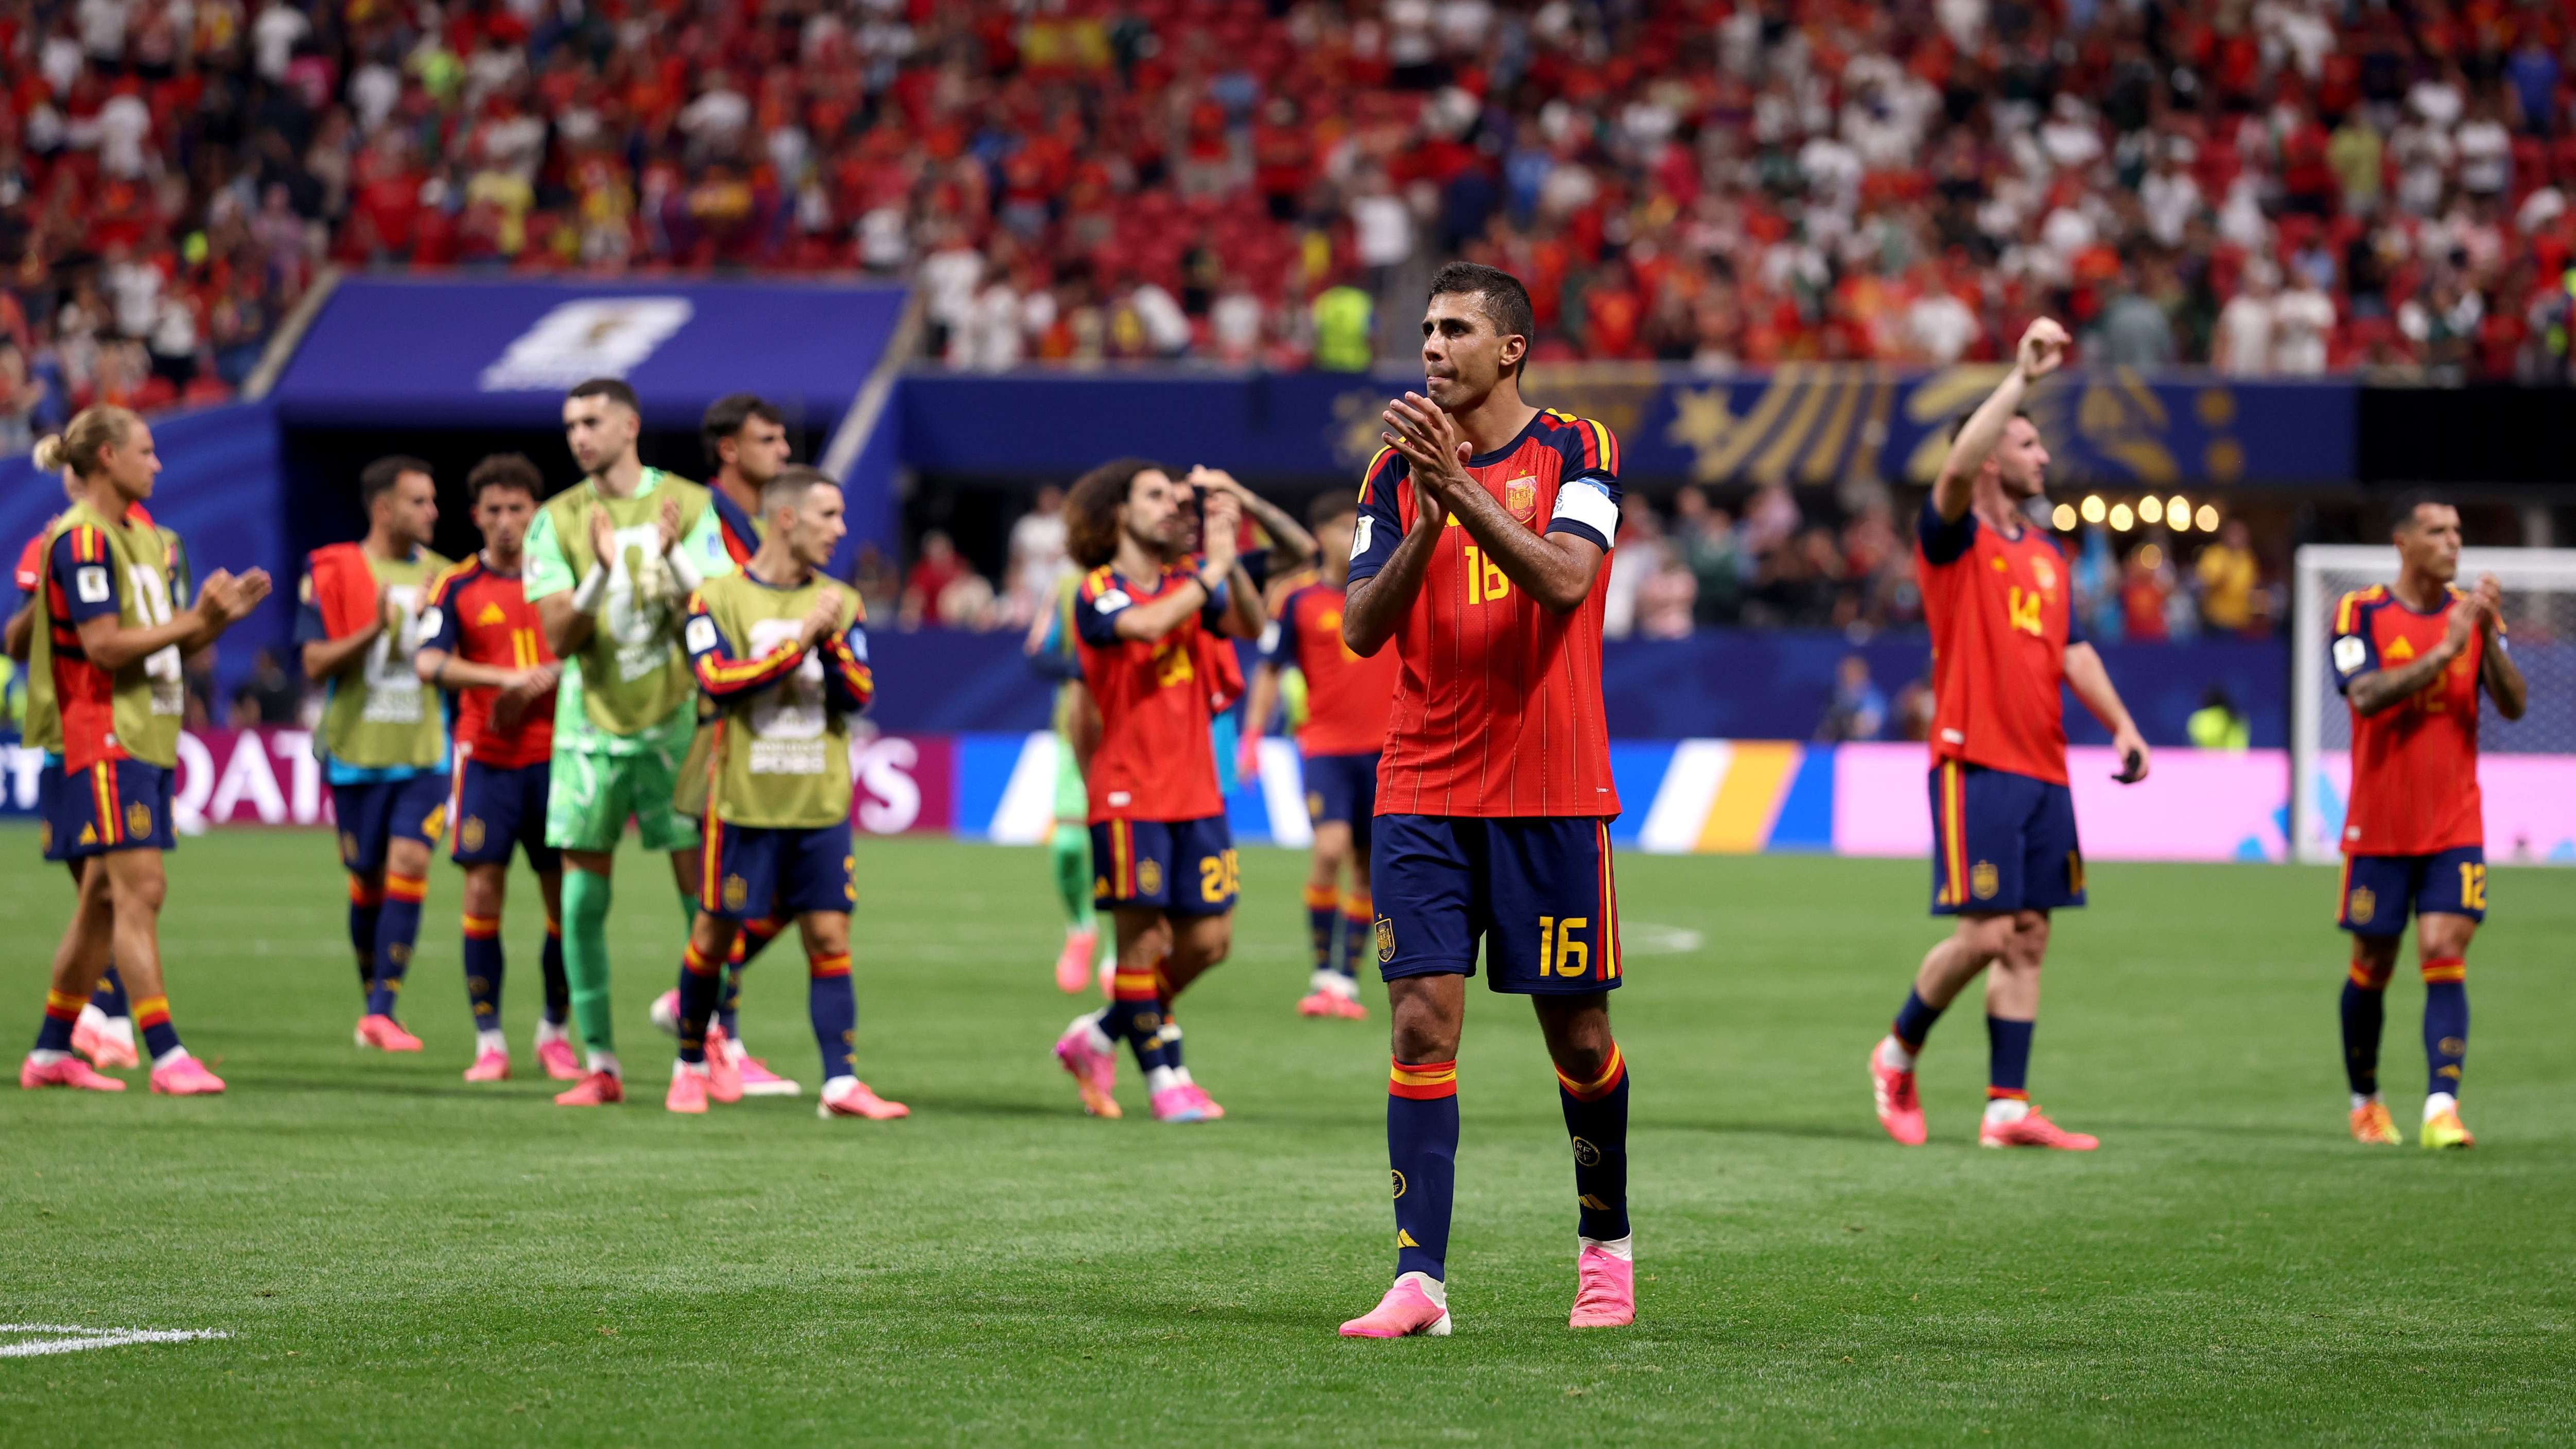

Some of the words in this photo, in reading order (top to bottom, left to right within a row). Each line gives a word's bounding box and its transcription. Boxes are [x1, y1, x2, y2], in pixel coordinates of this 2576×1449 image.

[1464, 546, 1509, 605] 16
[2459, 862, 2486, 911] 12
[1539, 916, 1588, 977] 16
